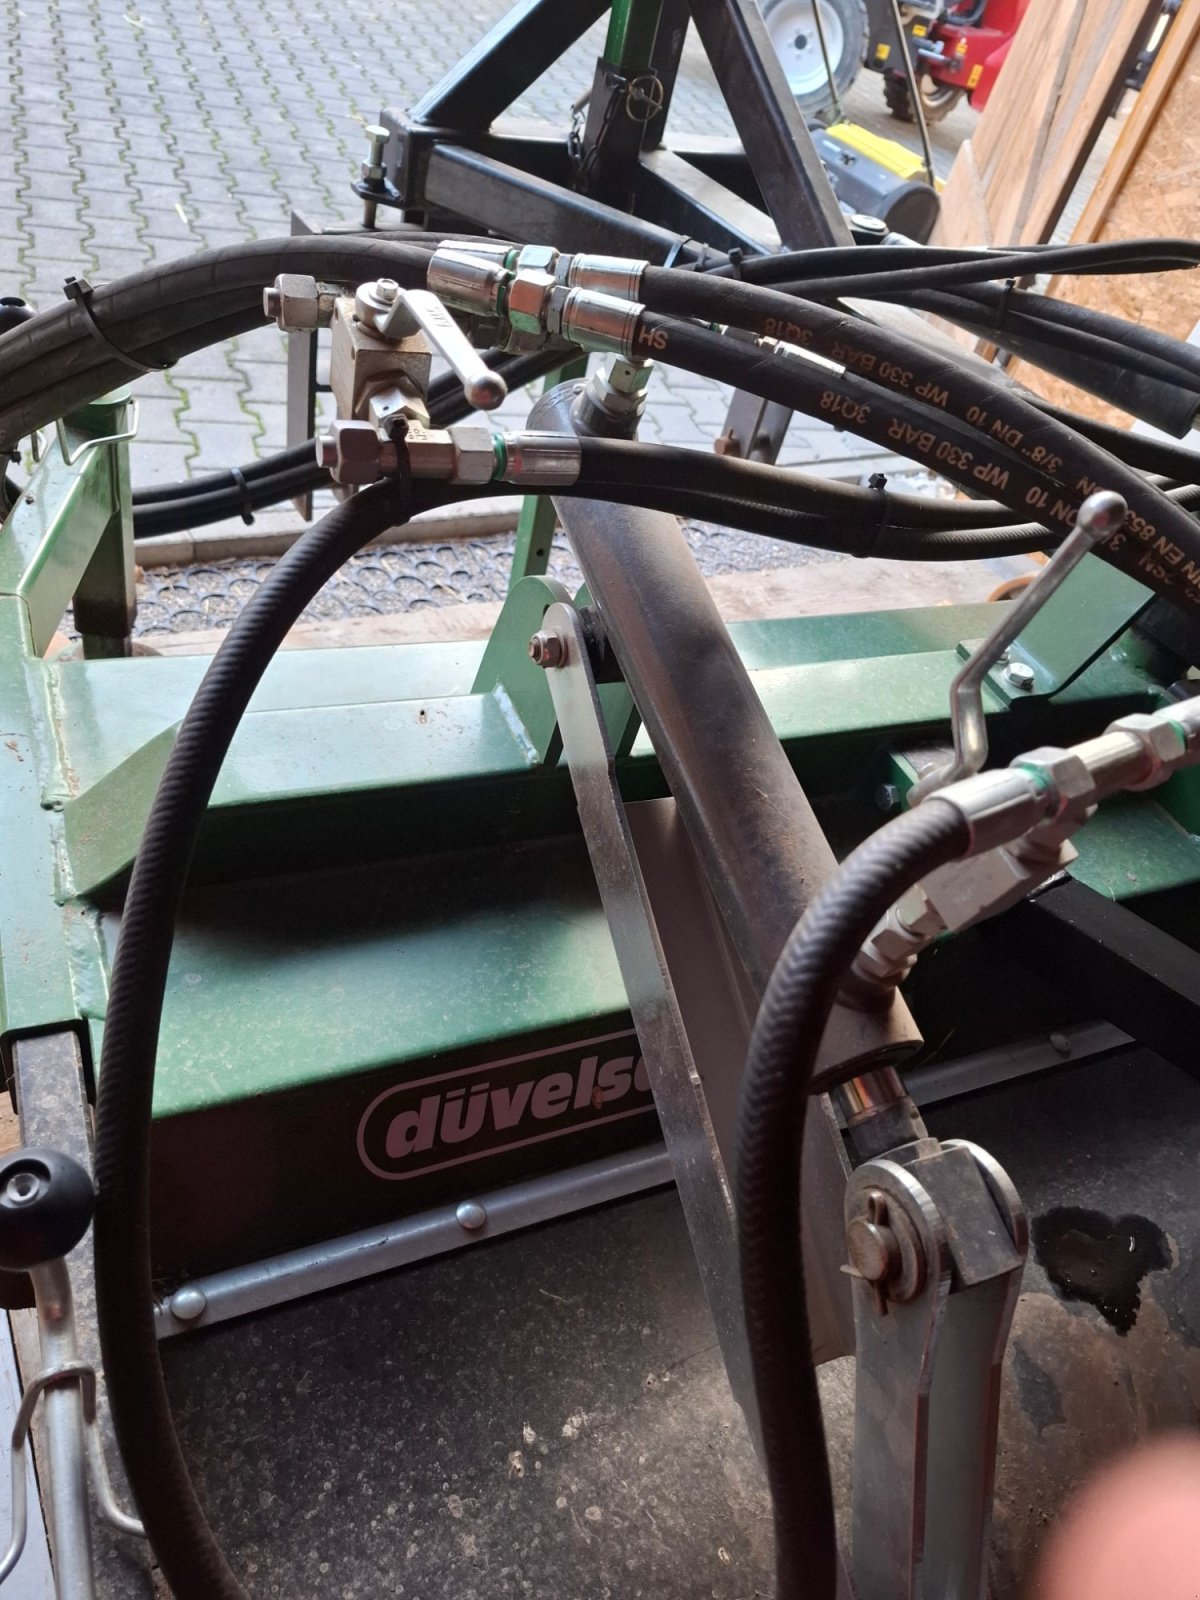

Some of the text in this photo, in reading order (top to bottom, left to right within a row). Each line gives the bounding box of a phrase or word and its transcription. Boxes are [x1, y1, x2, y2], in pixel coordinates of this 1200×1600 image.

[637, 325, 670, 350] SH
[831, 341, 877, 371] BAR
[879, 361, 914, 388] 330
[914, 382, 949, 407] WP
[966, 406, 988, 426] 10
[887, 418, 937, 453] BAR
[990, 419, 1024, 448] DN
[936, 441, 974, 470] 330
[972, 463, 1010, 490] WP
[1025, 486, 1049, 508] 10
[1153, 536, 1186, 565] EN
